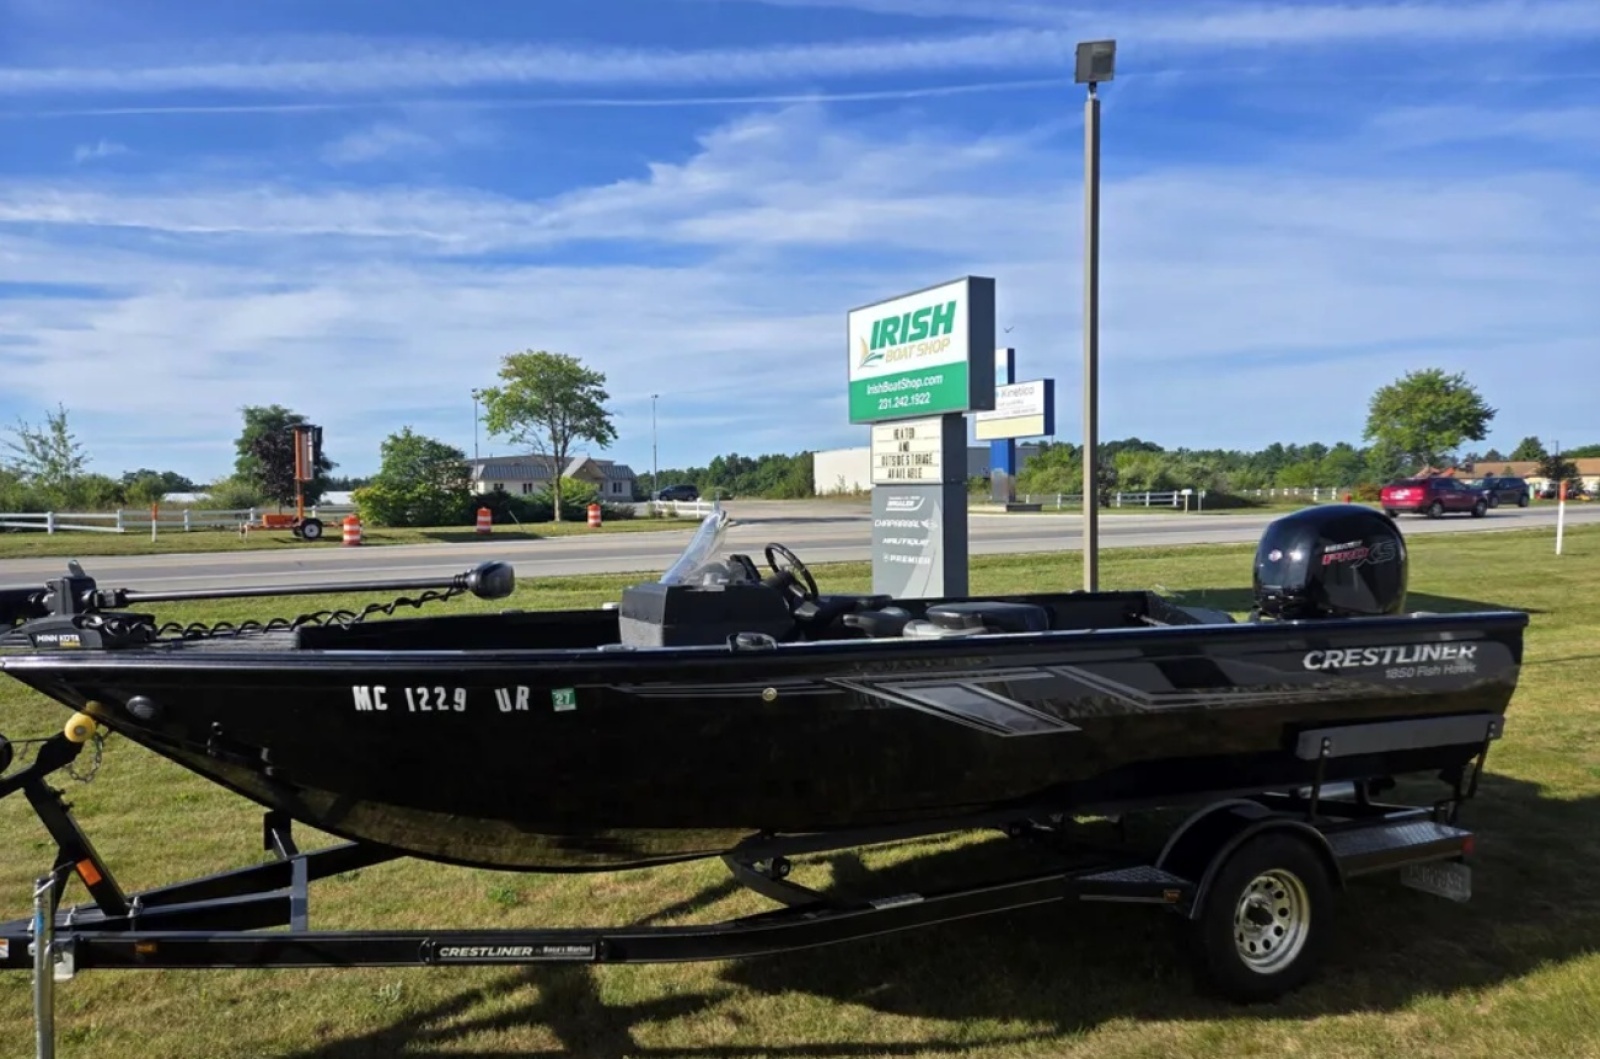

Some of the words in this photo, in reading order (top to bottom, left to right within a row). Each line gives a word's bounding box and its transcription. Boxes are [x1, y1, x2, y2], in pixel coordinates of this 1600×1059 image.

[870, 300, 957, 351] IRISH
[885, 345, 914, 363] BOAT
[916, 338, 950, 357] SHOP
[866, 375, 943, 395] IrishBoatShop.com
[899, 441, 910, 452] AND
[890, 554, 931, 565] PREMIER
[1303, 643, 1477, 670] CRESTLINER
[1385, 667, 1414, 679] 1850
[1416, 665, 1441, 677] Fish
[352, 685, 388, 711] MC
[404, 687, 467, 712] 1229
[493, 686, 530, 712] UR
[439, 946, 533, 957] CRESTLINER
